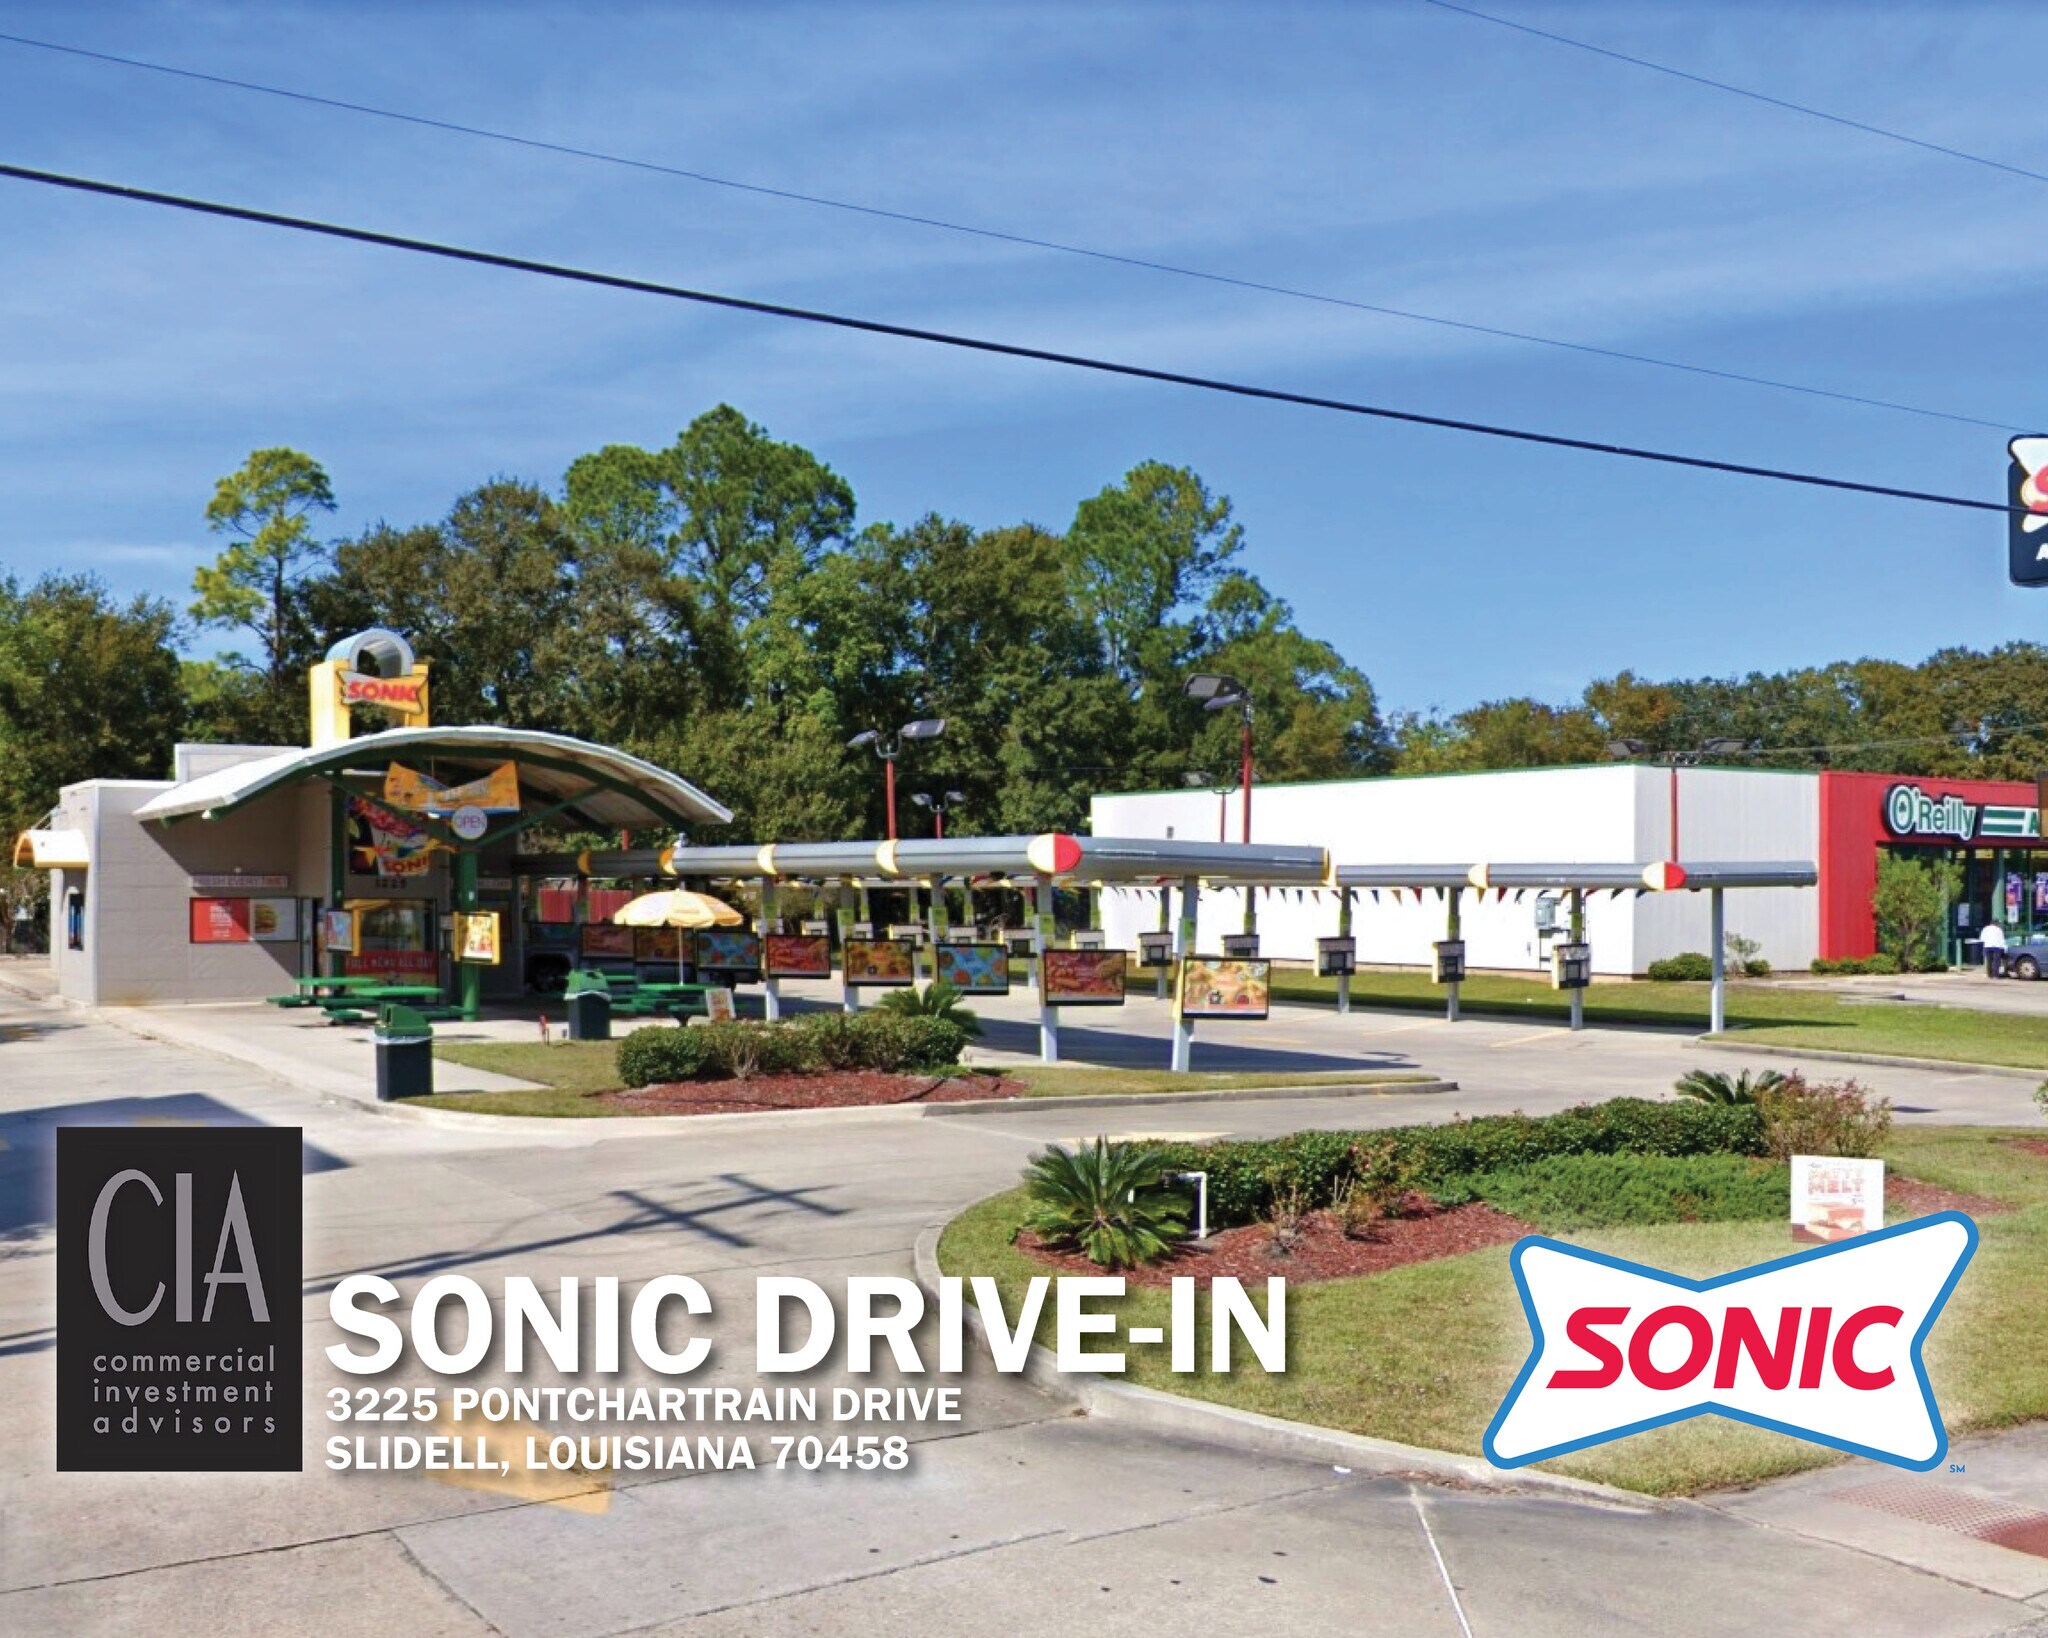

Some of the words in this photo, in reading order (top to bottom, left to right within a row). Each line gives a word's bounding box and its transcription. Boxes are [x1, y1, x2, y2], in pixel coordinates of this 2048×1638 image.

[348, 680, 420, 702] SONIC
[1889, 785, 1976, 839] O'Reilly
[455, 815, 484, 830] OPEN
[1808, 1178, 1864, 1194] MELT
